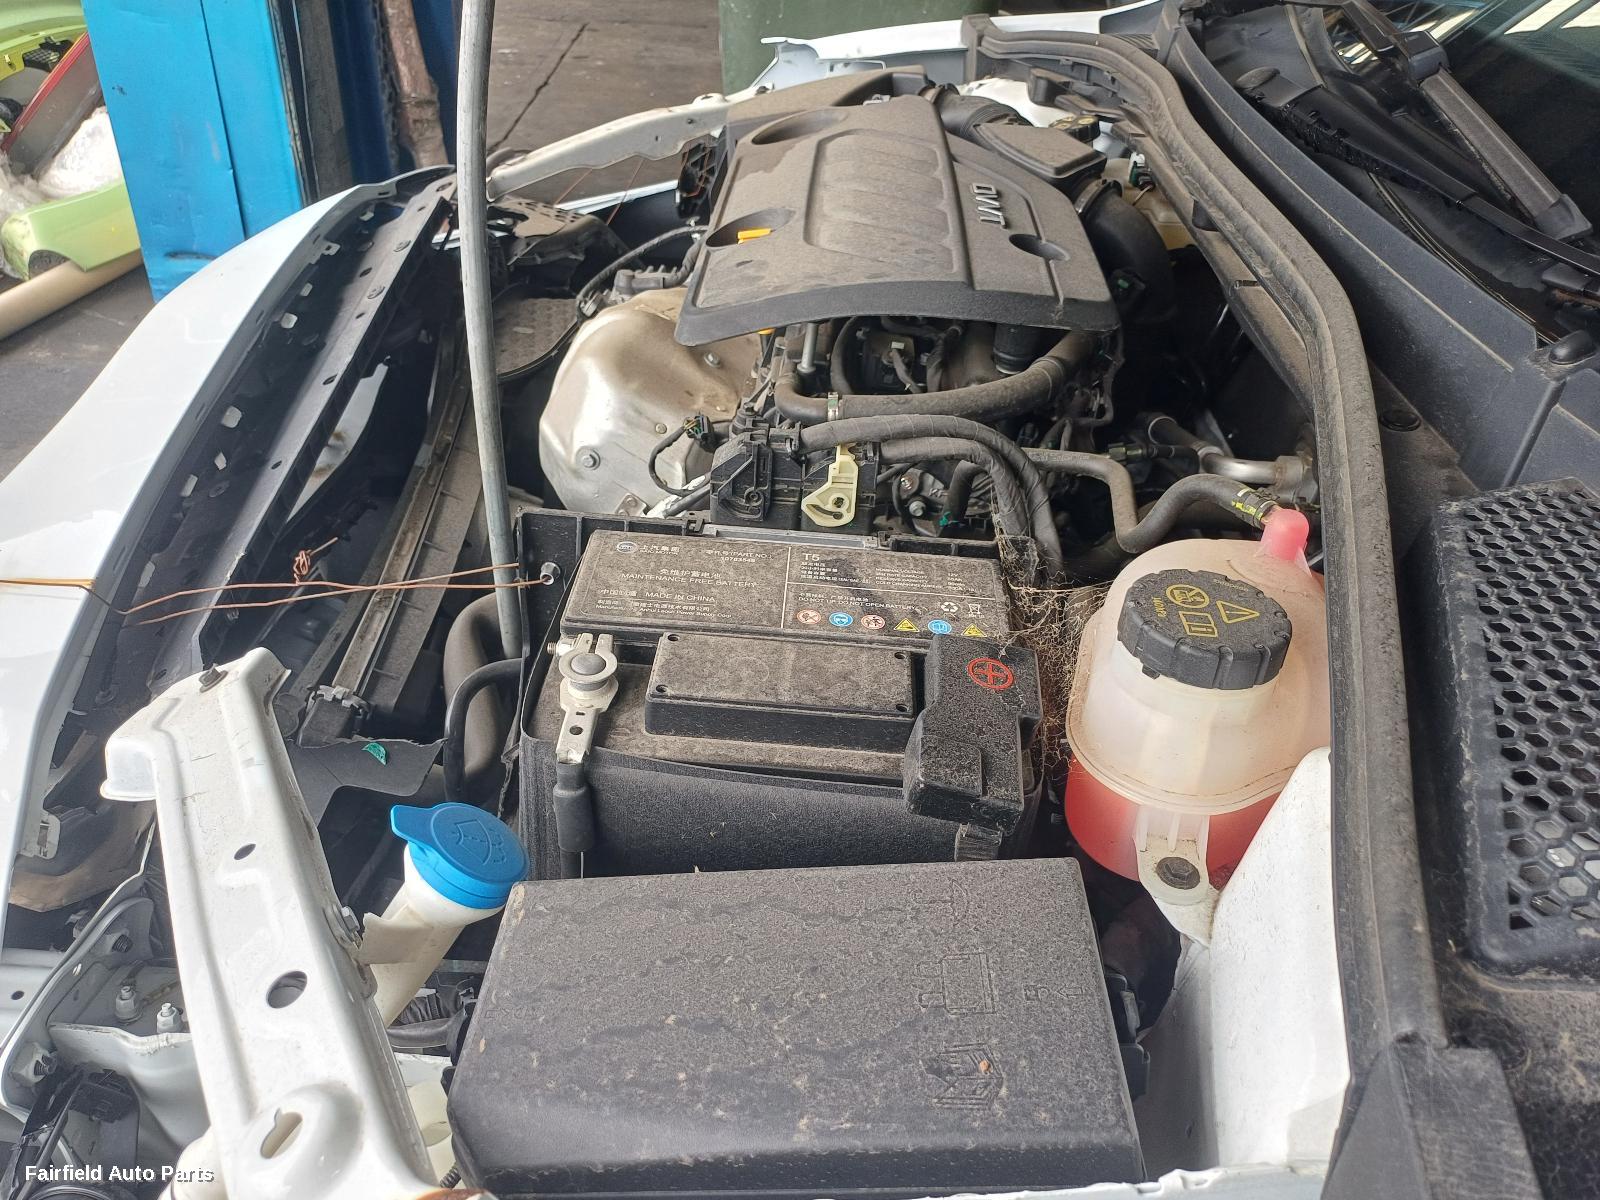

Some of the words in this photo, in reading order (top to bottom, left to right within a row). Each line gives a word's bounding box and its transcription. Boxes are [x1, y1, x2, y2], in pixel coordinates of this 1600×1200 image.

[971, 183, 1006, 227] DVVT
[803, 553, 820, 562] T5
[621, 572, 687, 583] MAINTENANCE
[689, 577, 714, 585] FREE
[715, 579, 758, 588] BATTERY
[645, 591, 672, 600] MADE
[686, 595, 716, 603] CHINA
